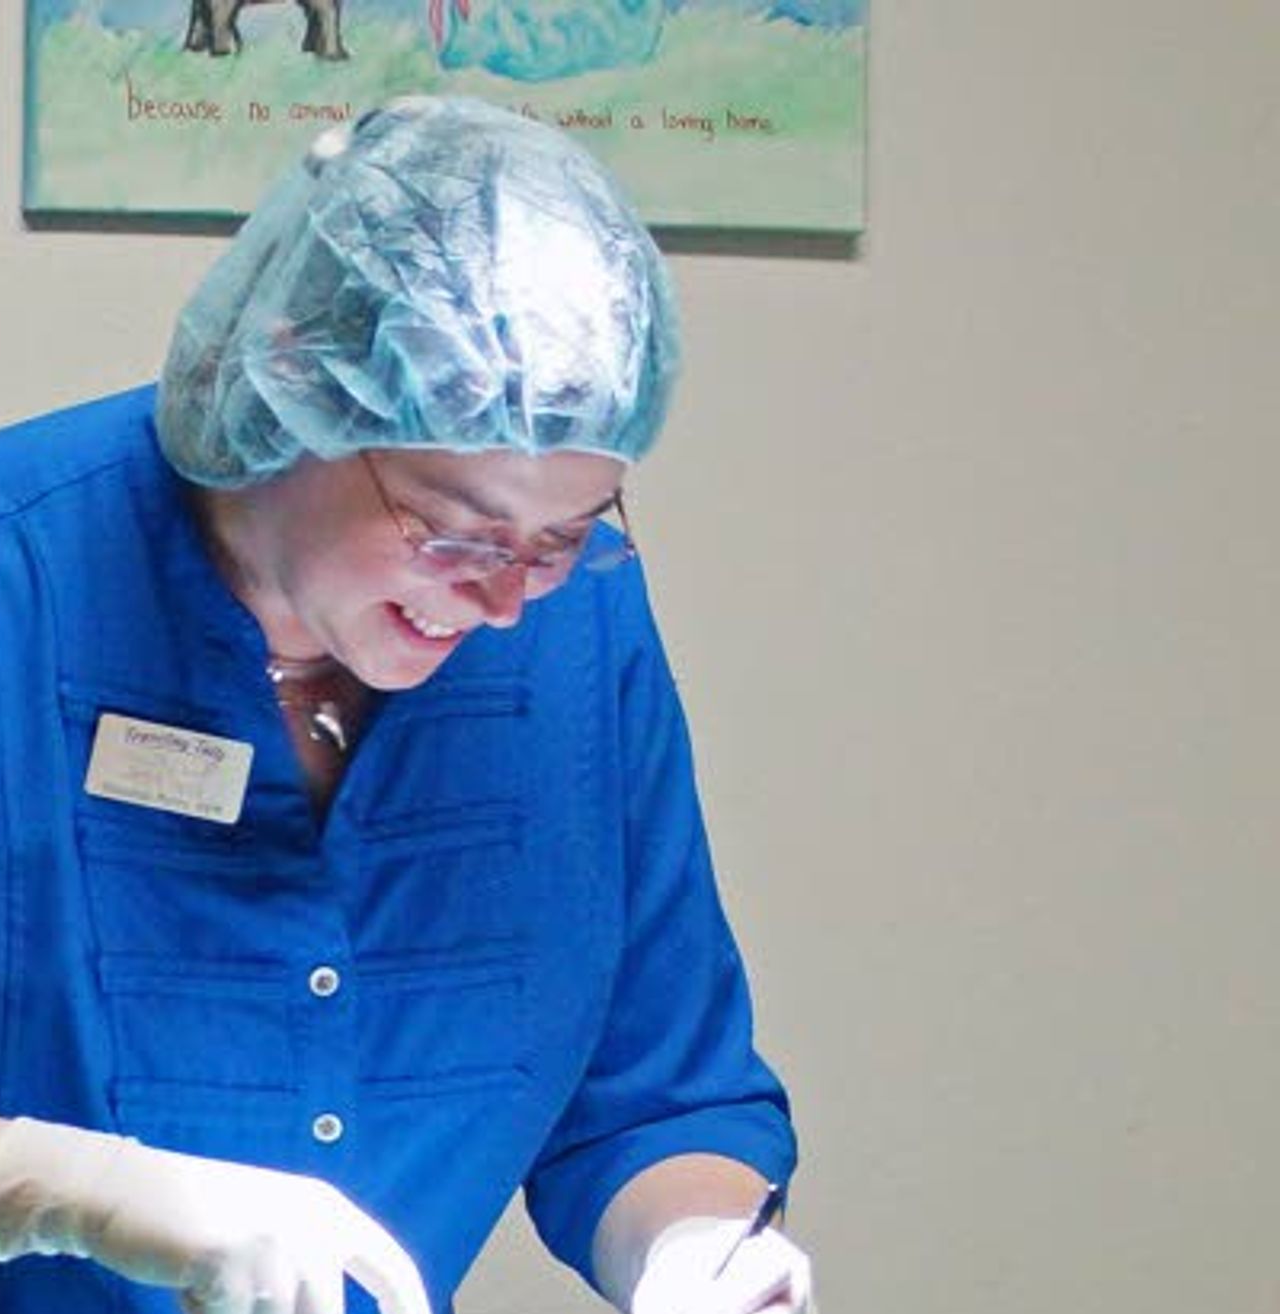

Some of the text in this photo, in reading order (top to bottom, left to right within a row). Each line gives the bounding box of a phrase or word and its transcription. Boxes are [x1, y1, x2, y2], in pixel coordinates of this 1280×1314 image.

[124, 76, 352, 121] because no animal
[630, 114, 645, 129] a
[662, 106, 715, 142] loving
